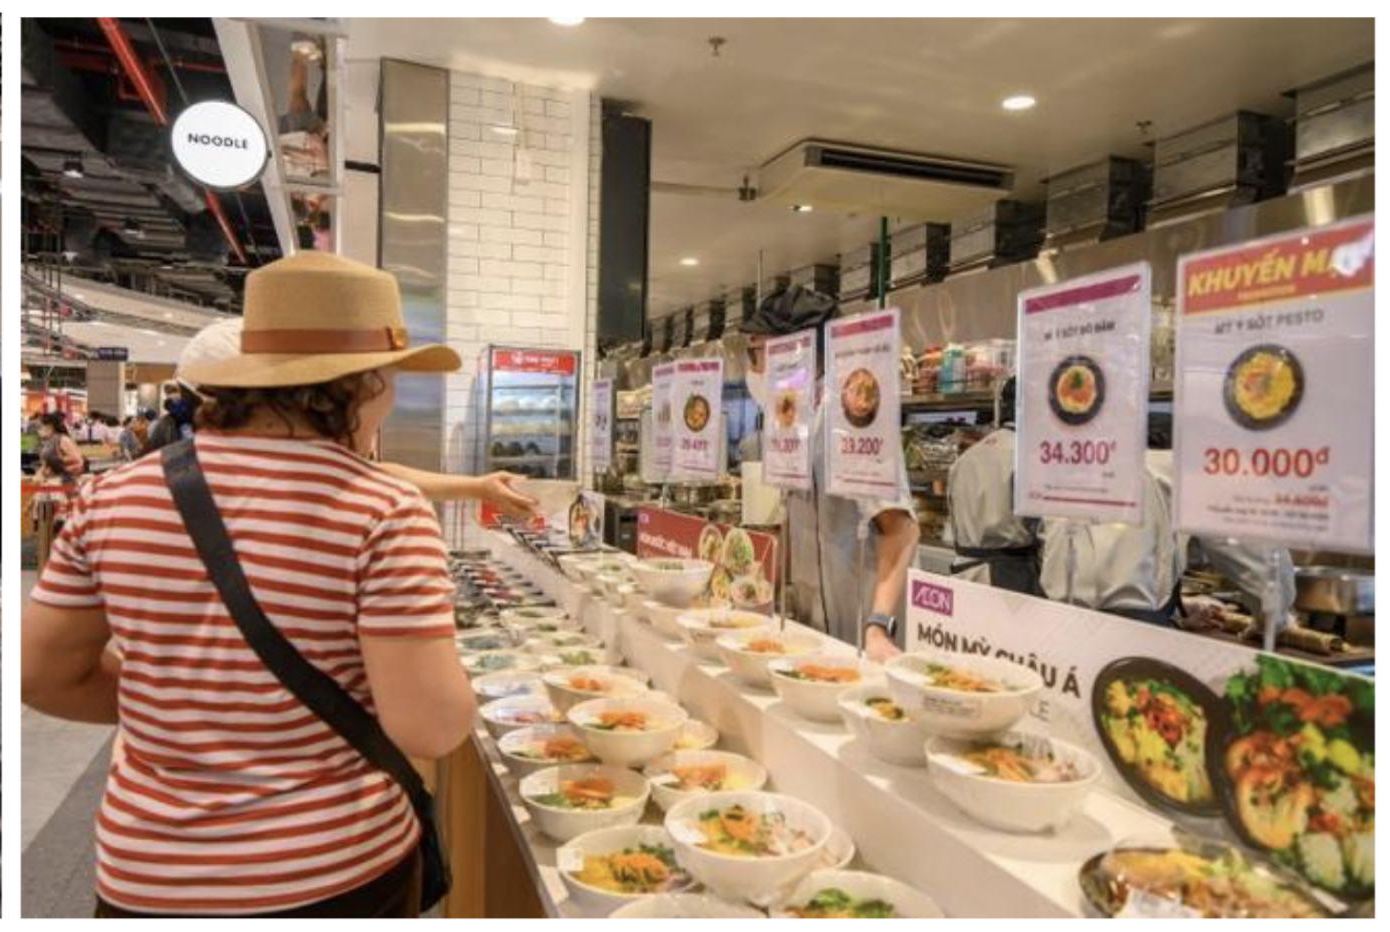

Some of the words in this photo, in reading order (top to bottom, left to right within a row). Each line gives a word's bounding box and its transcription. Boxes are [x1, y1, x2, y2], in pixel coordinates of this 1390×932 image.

[188, 133, 248, 149] NOODLE
[917, 622, 958, 652] MÓN
[995, 648, 1057, 688] ÂU
[1061, 665, 1081, 699] Á
